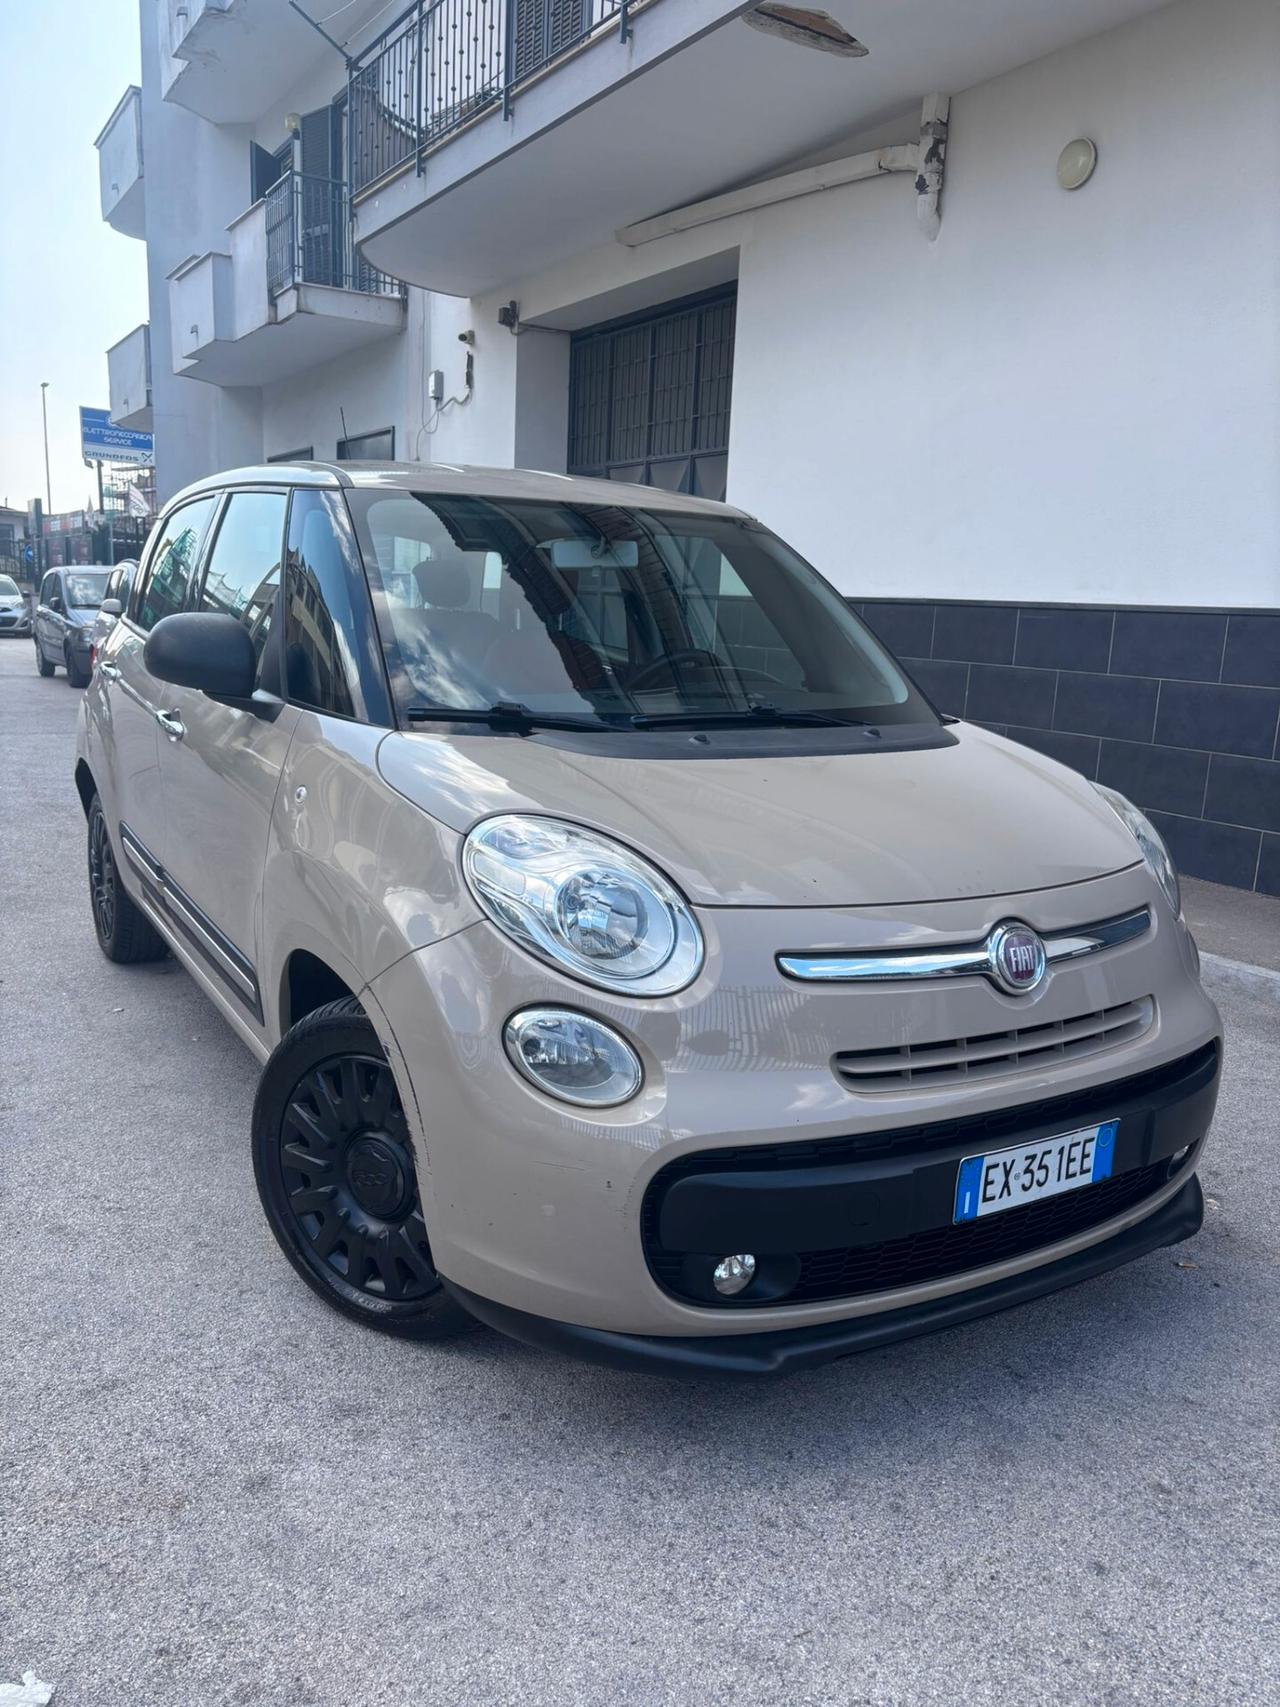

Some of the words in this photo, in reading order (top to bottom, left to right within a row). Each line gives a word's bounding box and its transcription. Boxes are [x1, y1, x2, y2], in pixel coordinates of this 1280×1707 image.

[103, 436, 132, 446] SERVICE
[84, 450, 140, 462] GRUNDFOS
[1009, 945, 1035, 972] FIAT
